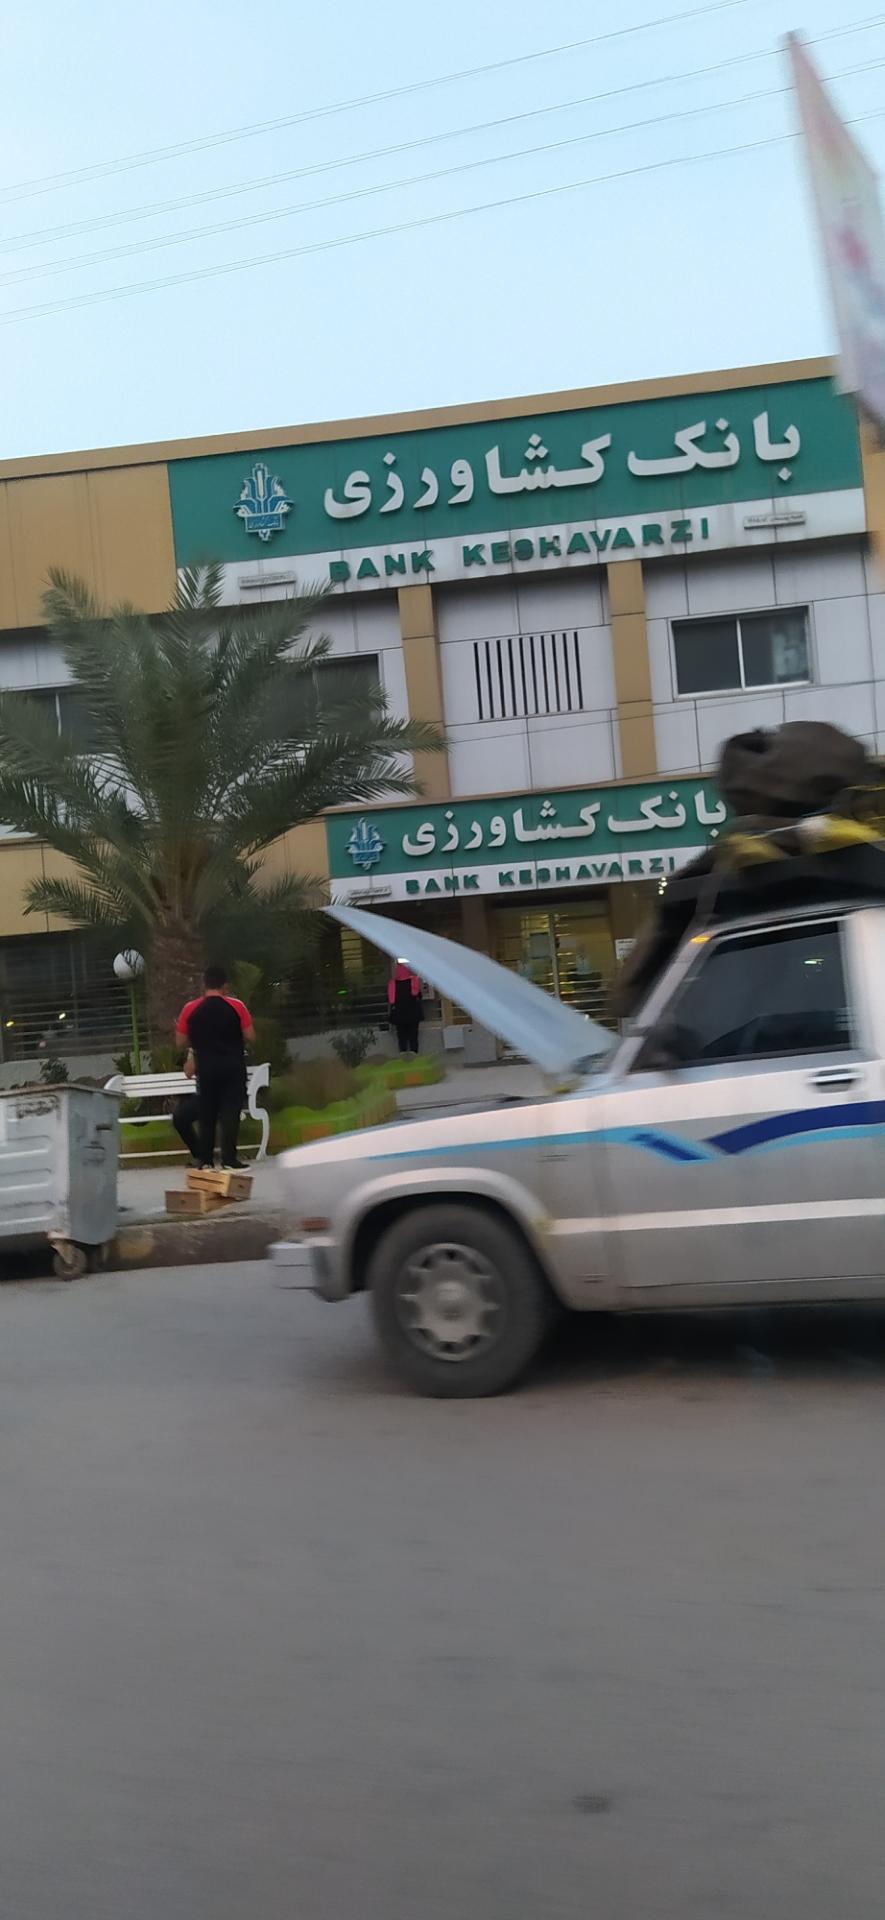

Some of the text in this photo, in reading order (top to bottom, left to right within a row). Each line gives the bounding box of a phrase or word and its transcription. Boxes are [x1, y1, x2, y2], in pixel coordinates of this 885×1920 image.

[324, 412, 801, 519] بانک کشاورزی
[330, 517, 710, 583] BANK KESHAVARZI
[401, 790, 727, 857] بانک کشاورزی
[405, 857, 675, 894] BANK KESHAVARZI
